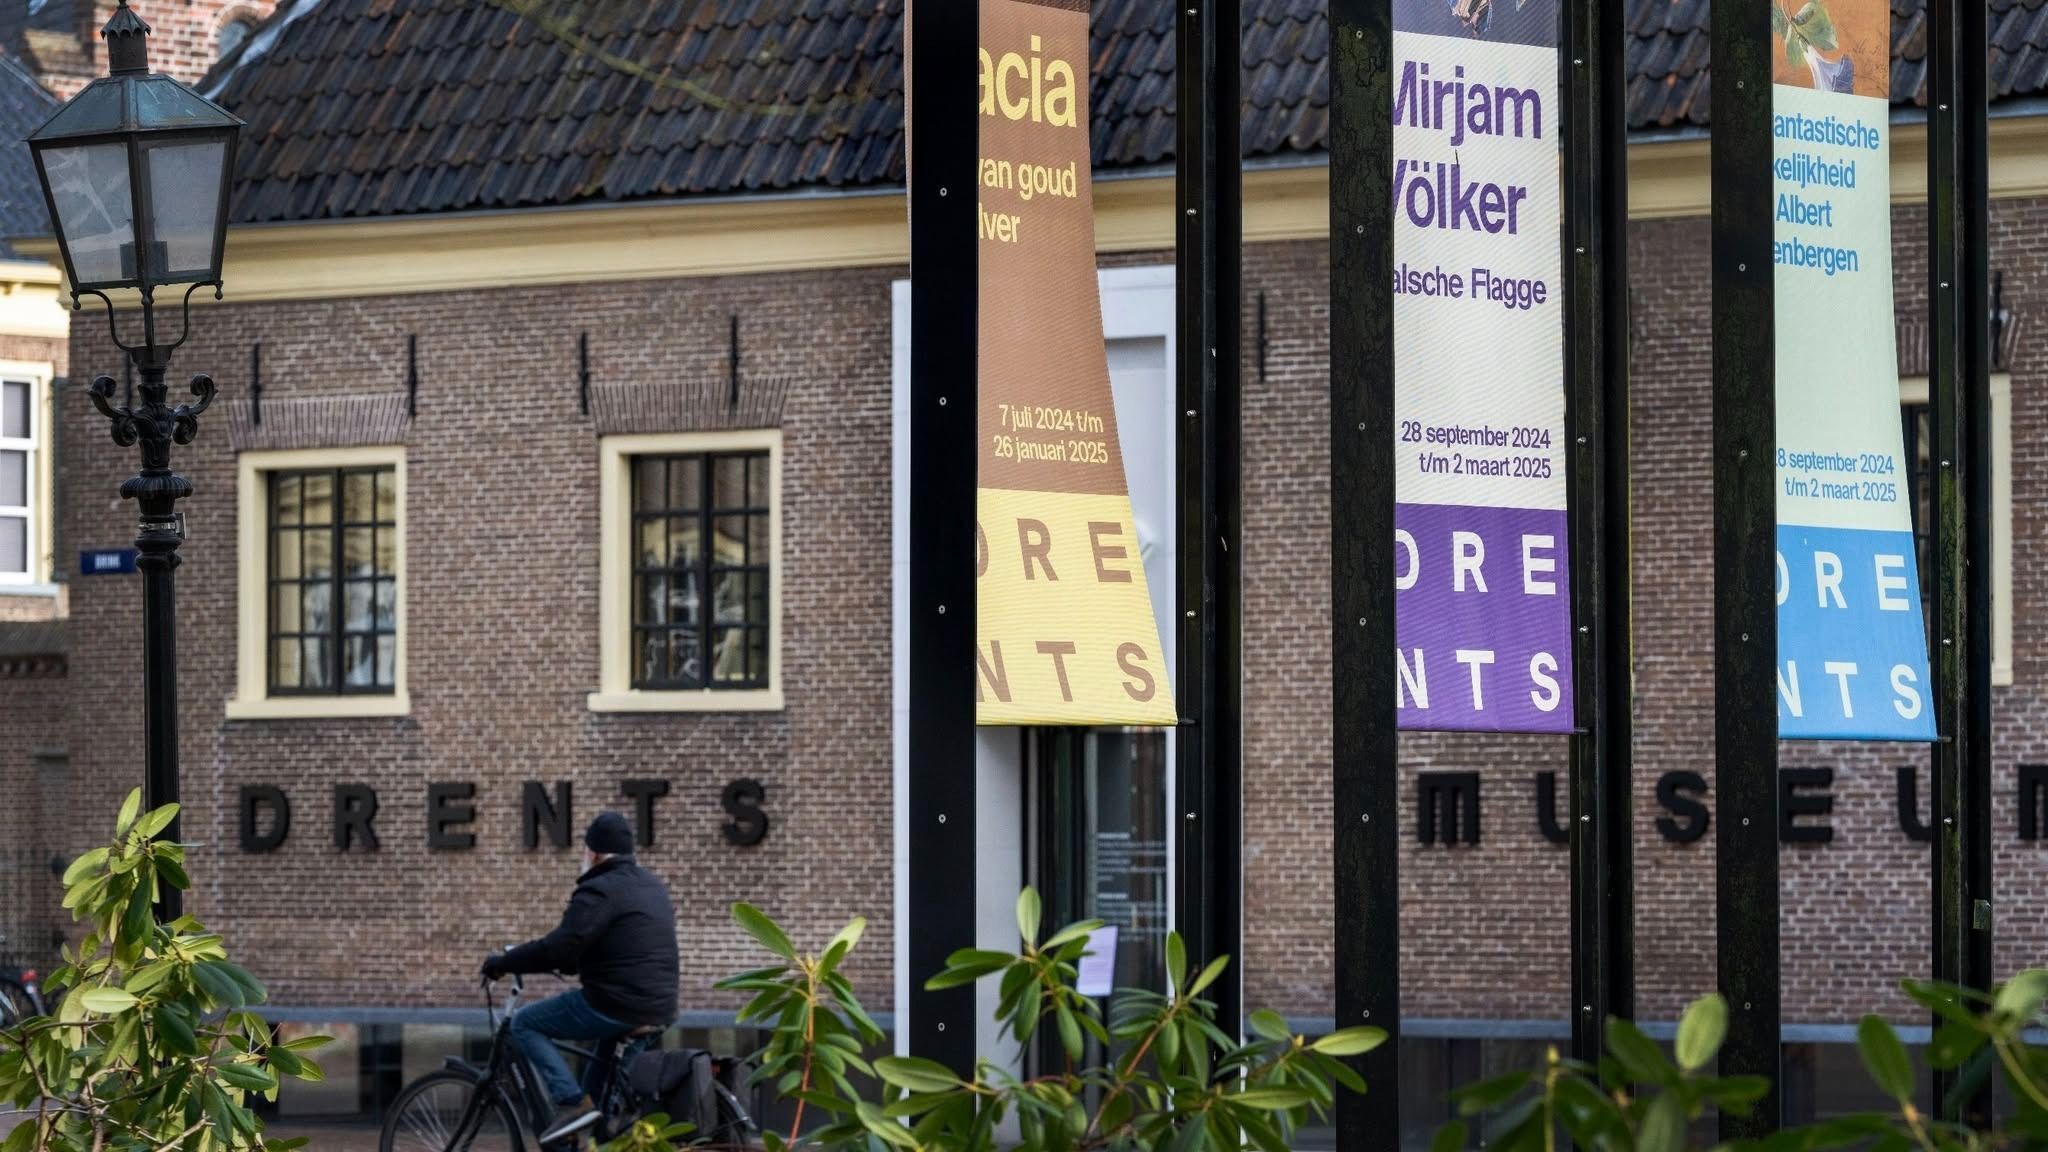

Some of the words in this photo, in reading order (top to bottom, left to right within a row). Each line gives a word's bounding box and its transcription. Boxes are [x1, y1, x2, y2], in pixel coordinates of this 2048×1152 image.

[1393, 60, 1541, 147] Mirjam
[1774, 113, 1879, 150] antastische
[1018, 161, 1077, 200] goud
[1776, 193, 1833, 227] Albert
[1774, 237, 1859, 276] enbergen
[1394, 263, 1464, 299] alsche
[1471, 268, 1547, 311] Flagge
[999, 404, 1008, 426] 7
[1011, 405, 1033, 431] juli
[1035, 407, 1074, 431] 2024
[1076, 411, 1104, 433] t/m
[1401, 421, 1422, 442] 28
[1426, 425, 1509, 448] september
[1512, 427, 1551, 449] 2024
[994, 435, 1013, 458] 26
[1016, 437, 1067, 463] januari
[1068, 440, 1108, 464] 2025
[1419, 452, 1449, 473] t/m
[1453, 453, 1463, 474] 2
[1466, 457, 1511, 476] maart
[1513, 456, 1551, 479] 2025
[1776, 447, 1786, 467] 8
[1789, 452, 1857, 473] september
[1860, 454, 1894, 475] 2024
[1785, 477, 1808, 497] t/m
[1810, 478, 1819, 497] 2
[1822, 483, 1860, 500] maart
[1862, 482, 1897, 502] 2025
[977, 518, 1132, 583] RE
[1396, 528, 1556, 595] DRE
[977, 640, 1156, 703] NTS
[1397, 648, 1561, 712] NTS
[1777, 660, 1922, 720] NTS
[239, 777, 770, 852] DRENTS
